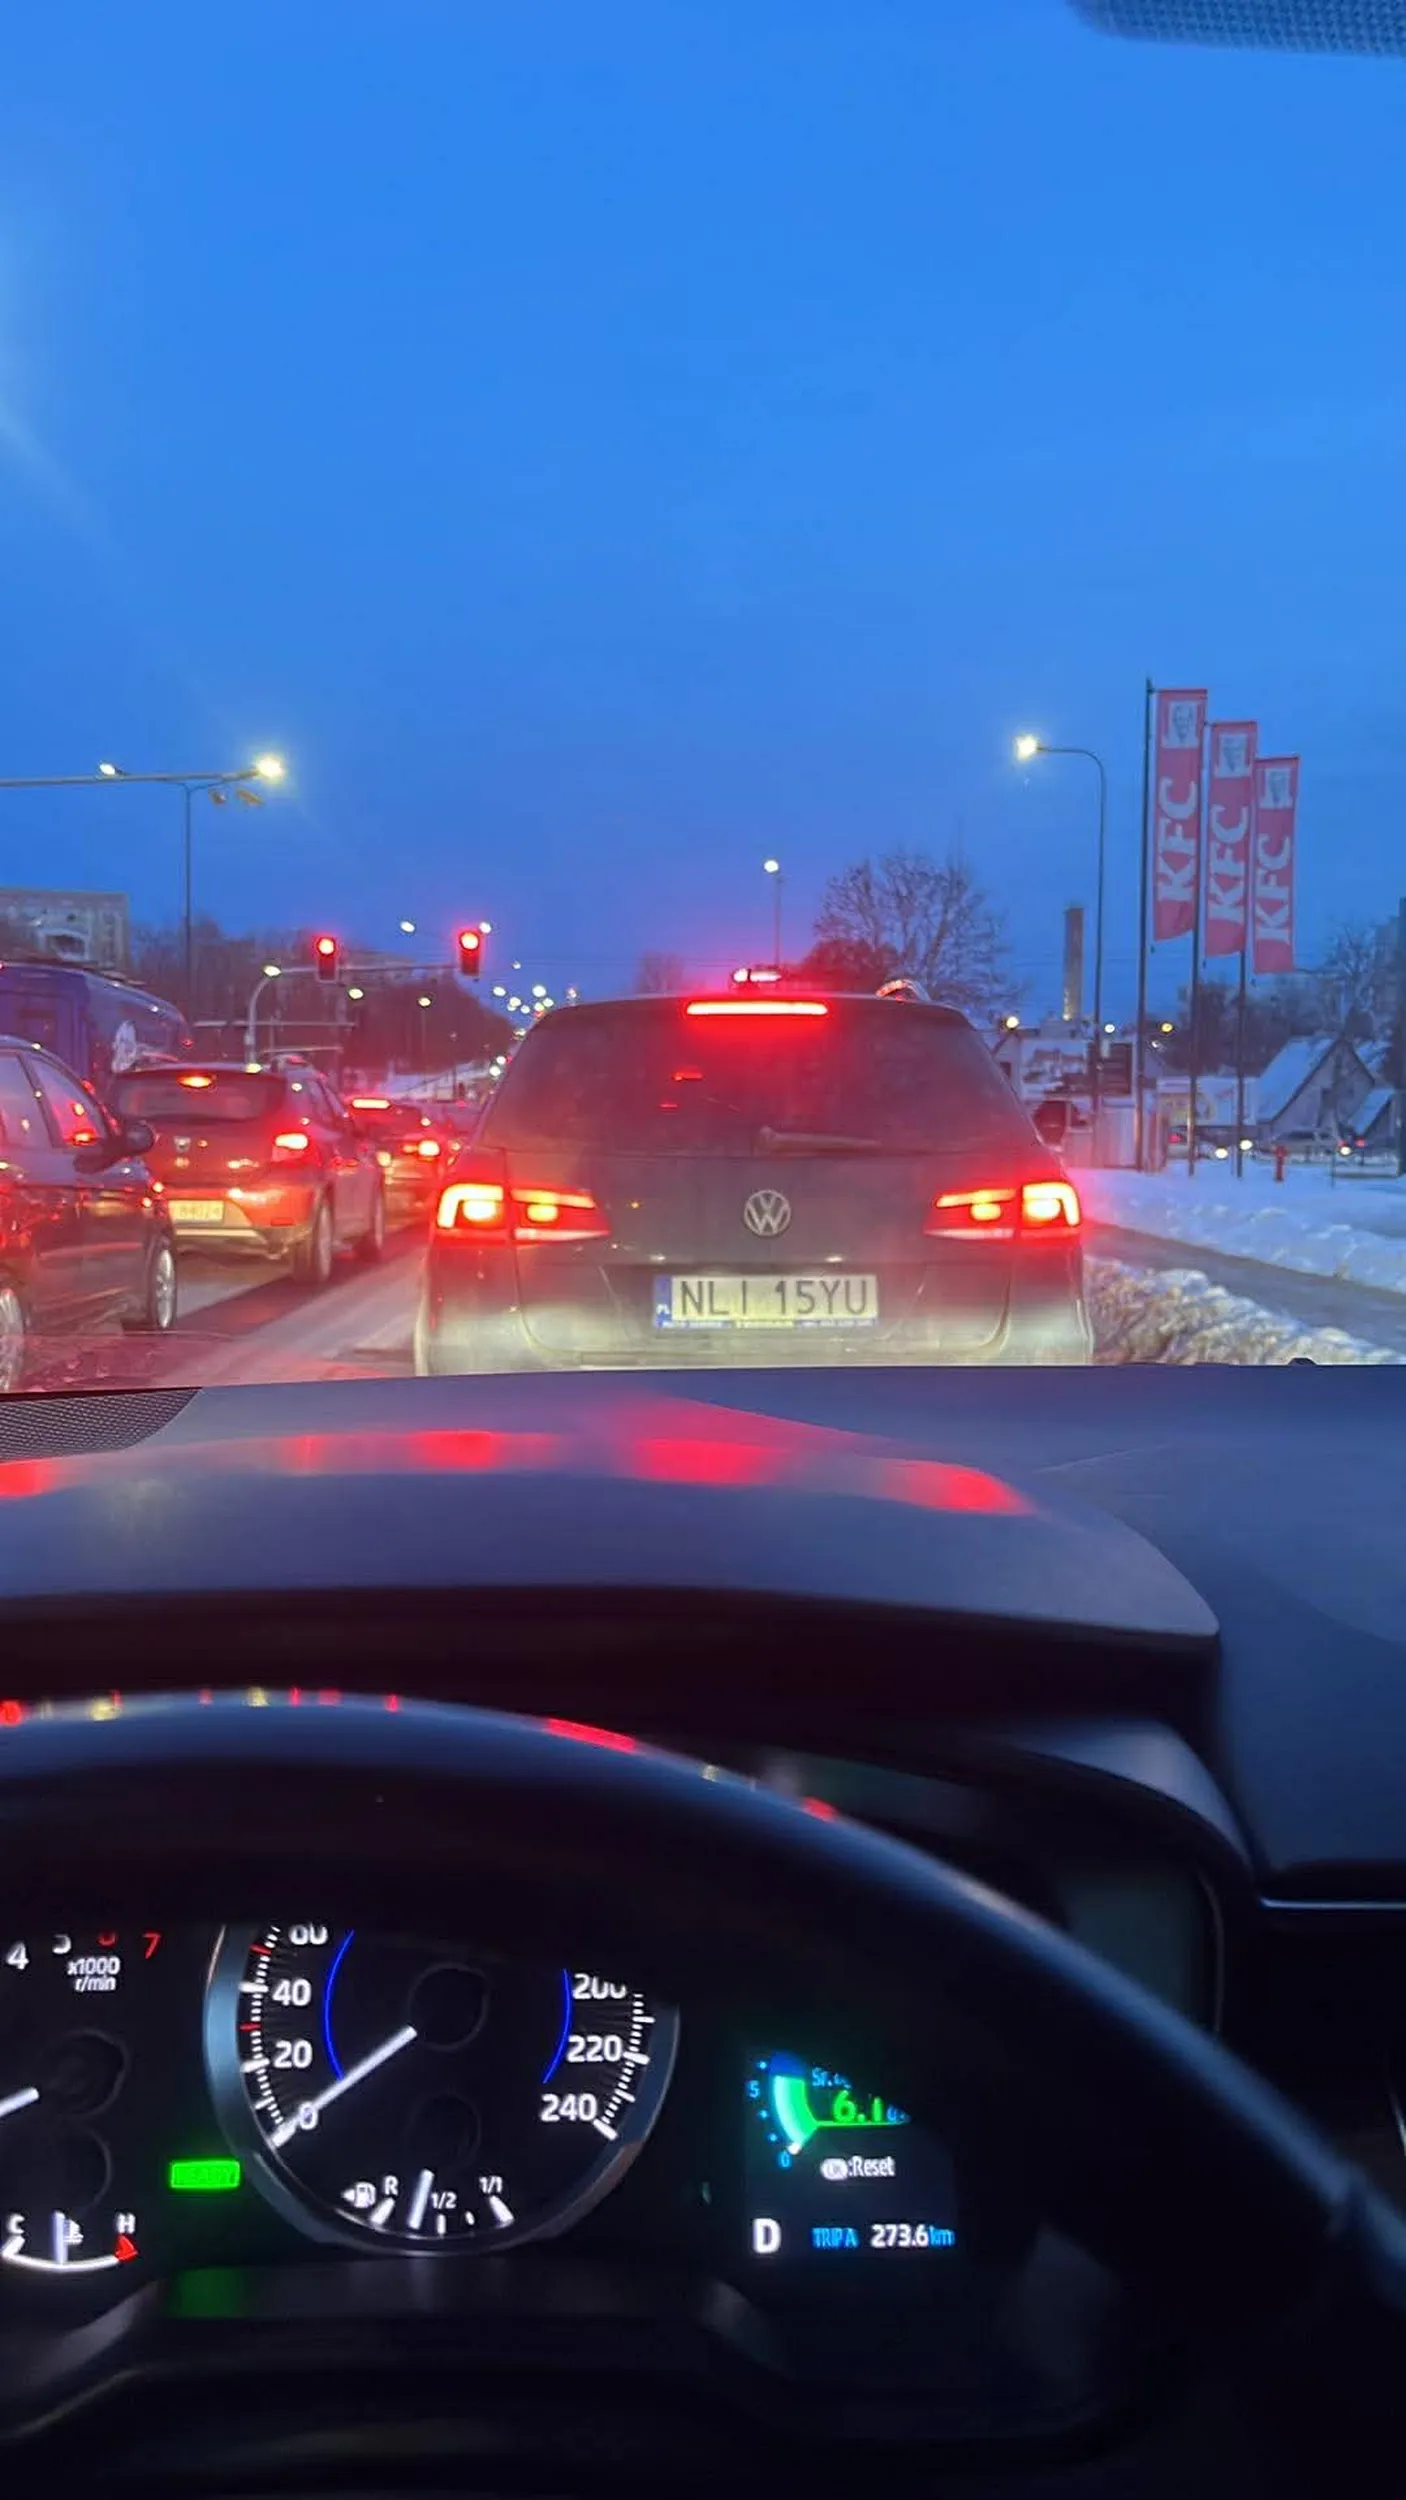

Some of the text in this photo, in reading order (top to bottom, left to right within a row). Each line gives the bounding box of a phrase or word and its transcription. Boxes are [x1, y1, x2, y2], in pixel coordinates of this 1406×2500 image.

[1157, 777, 1198, 901] KFC
[1208, 804, 1249, 925] KFC
[1255, 833, 1291, 945] KFC
[775, 1280, 867, 1316] 15YU
[6, 1941, 30, 1970] 4
[142, 1932, 162, 1960] 7
[67, 1956, 121, 1975] x1000
[74, 1976, 117, 1992] r/min
[272, 1978, 312, 2006] 40
[273, 2039, 313, 2069] 20
[567, 2035, 622, 2062] 220
[750, 2080, 760, 2098] 5
[299, 2102, 319, 2130] 0
[540, 2093, 598, 2122] 240
[383, 2175, 398, 2195] R
[479, 2176, 503, 2193] 1/1
[431, 2192, 457, 2209] 1/2
[7, 2214, 25, 2234] C
[116, 2213, 136, 2233] H
[753, 2218, 782, 2254] D
